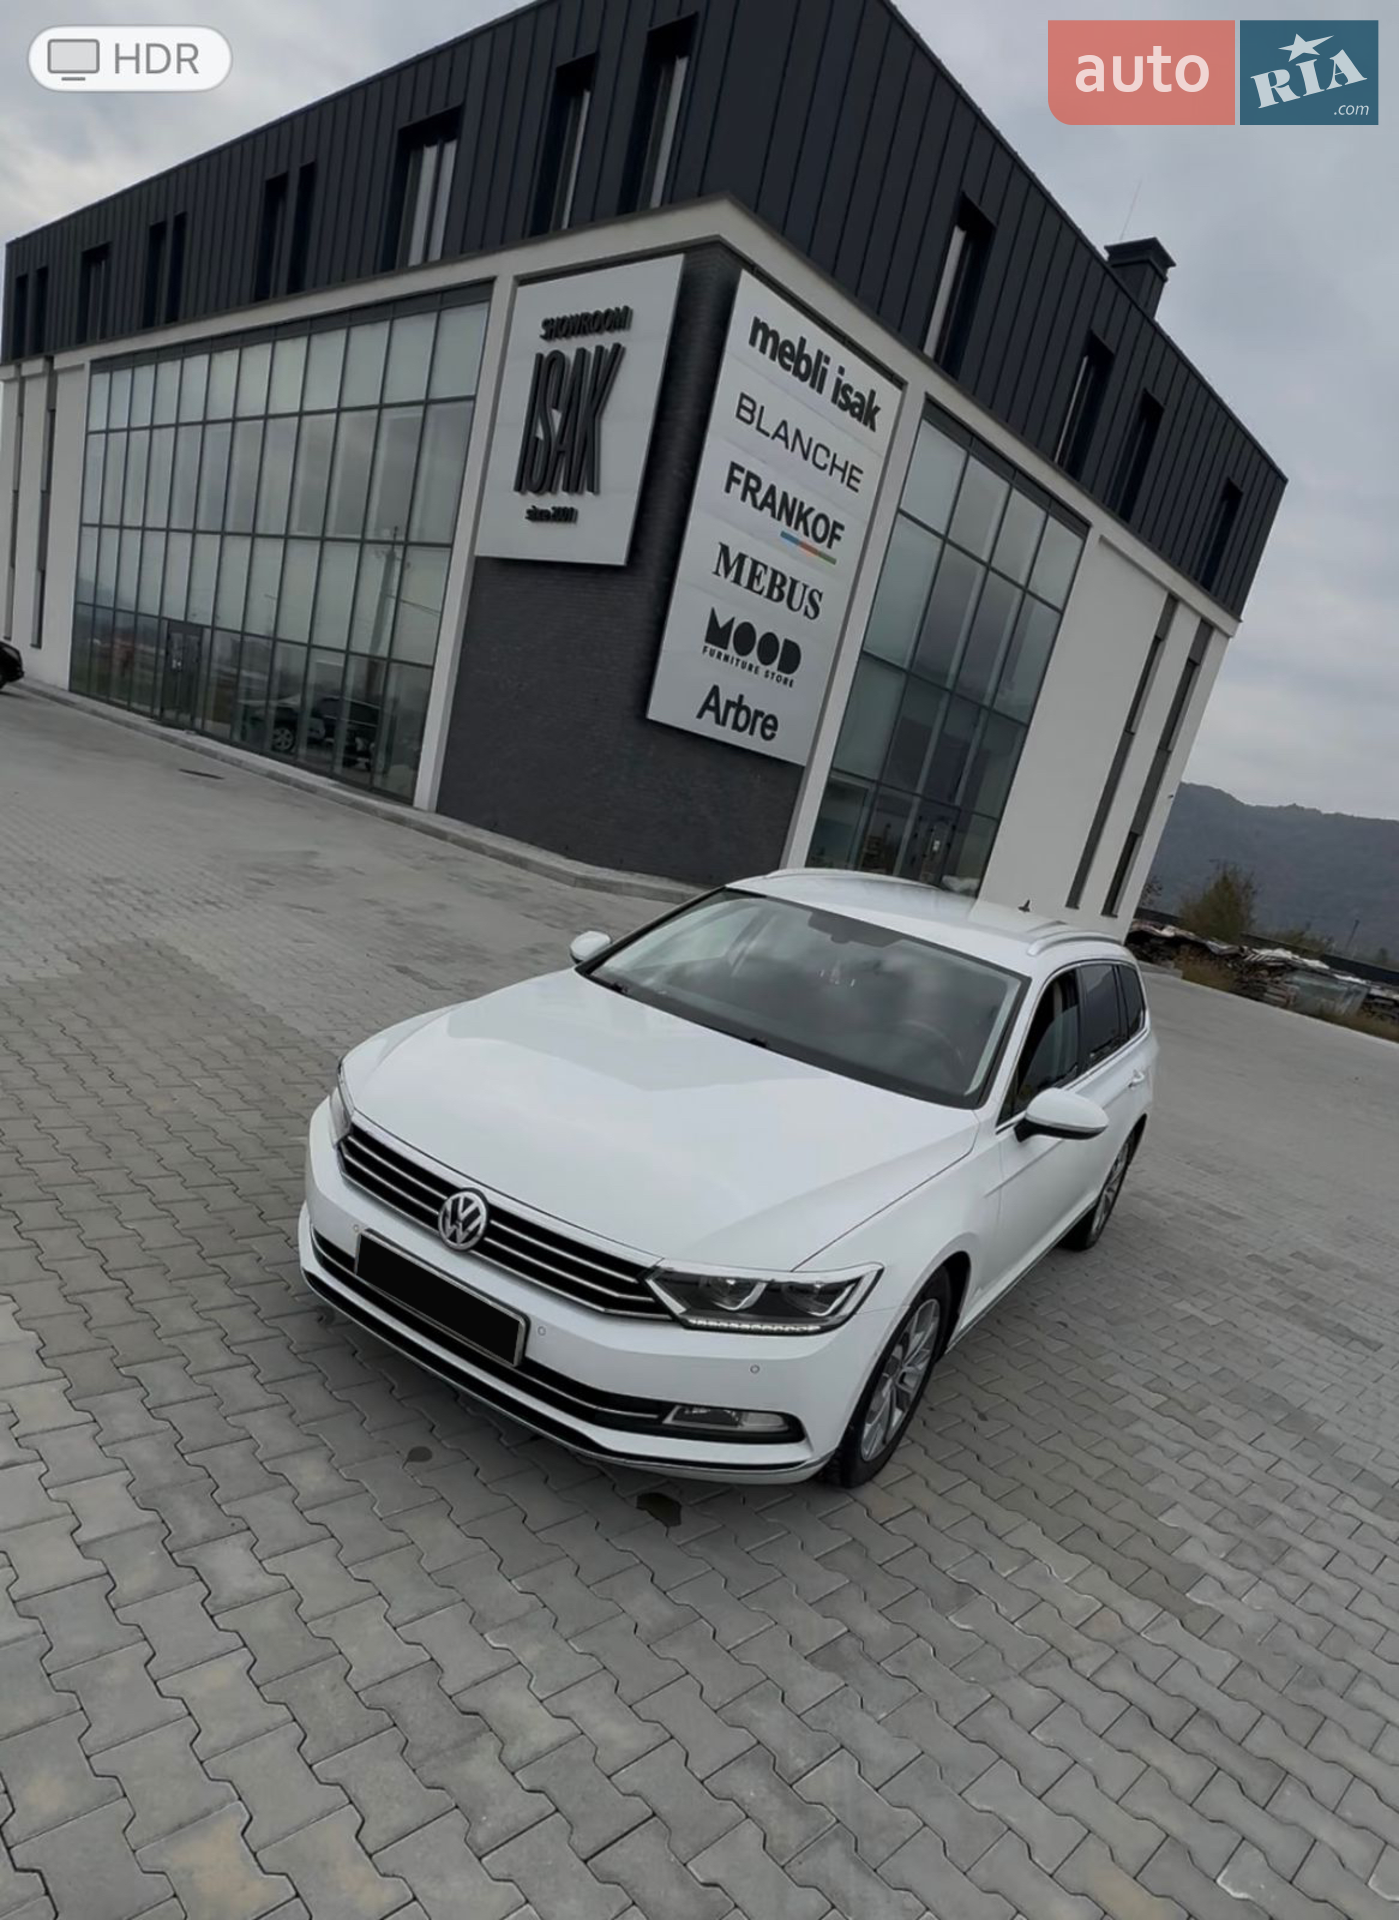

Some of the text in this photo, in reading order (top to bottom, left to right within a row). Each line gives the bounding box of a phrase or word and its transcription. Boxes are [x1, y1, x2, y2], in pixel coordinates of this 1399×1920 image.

[540, 305, 633, 341] SHOWROOM
[748, 316, 882, 433] mebli isak
[513, 342, 626, 496] ISAK
[735, 392, 864, 493] BLANCHE
[724, 461, 845, 549] FRANKOF
[712, 541, 823, 620] MEBUS
[702, 645, 760, 675] FURNITURE
[704, 607, 802, 675] MOOD
[696, 669, 795, 741] STORE Arbre
